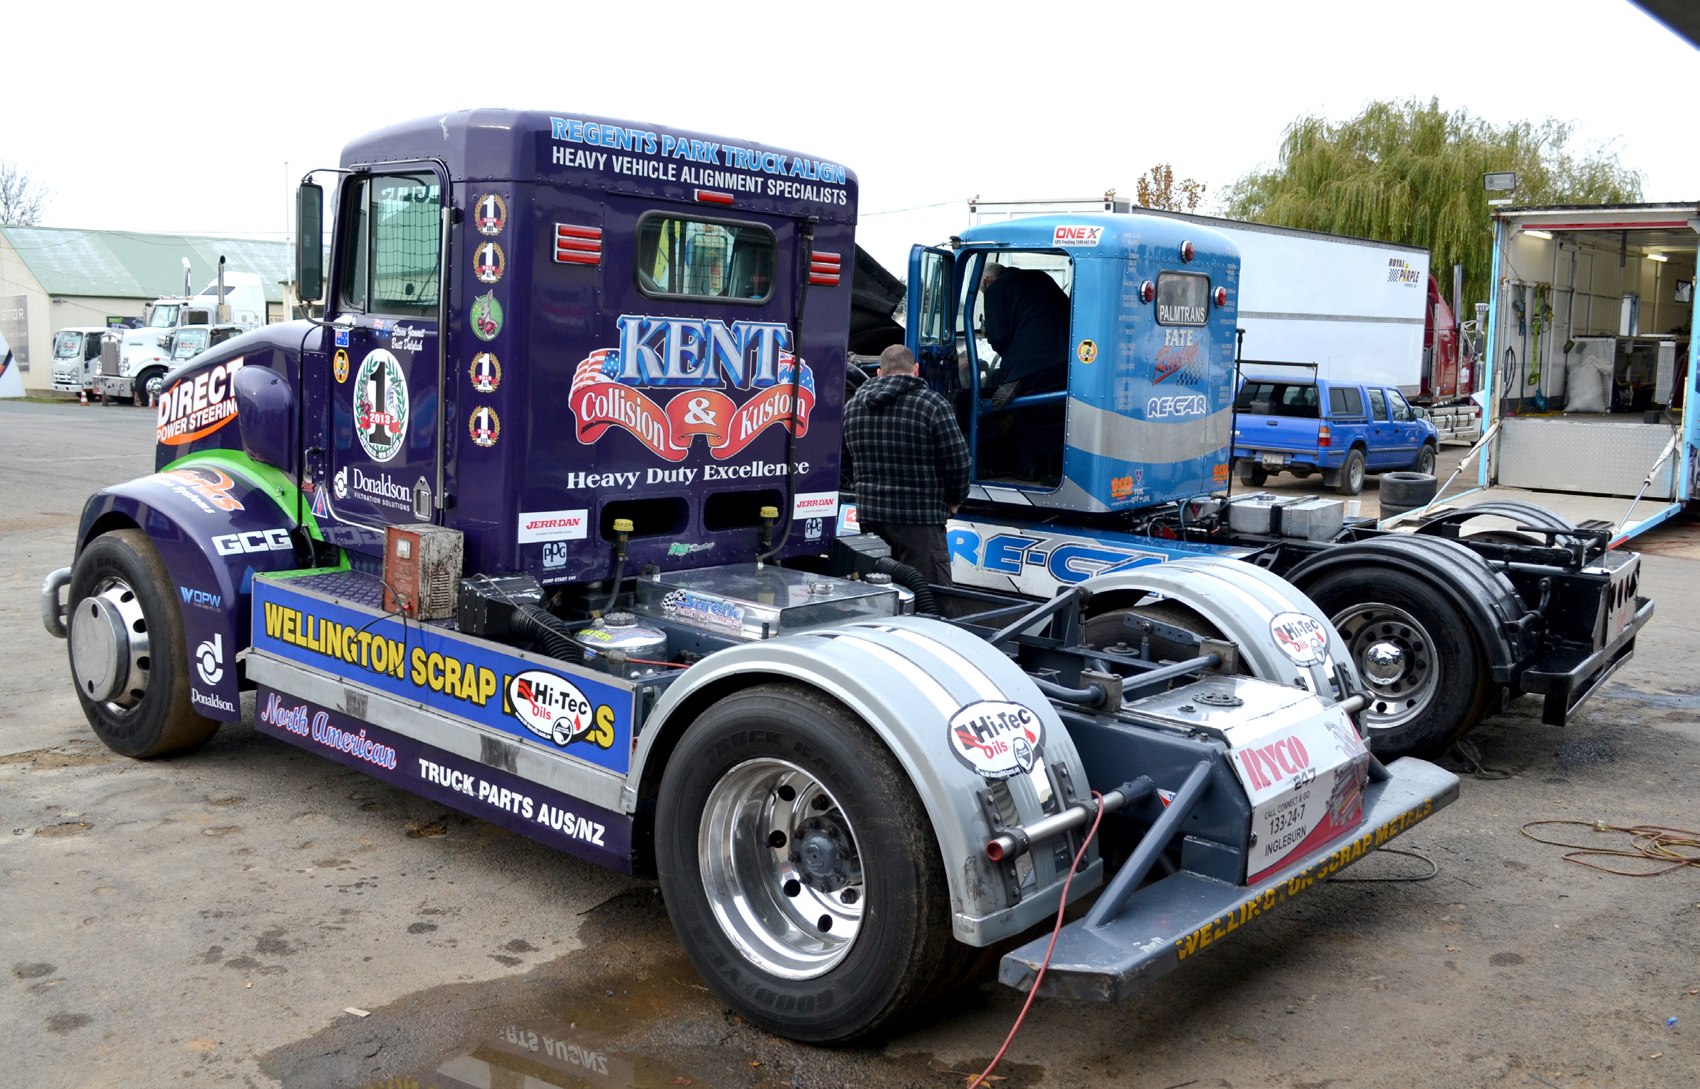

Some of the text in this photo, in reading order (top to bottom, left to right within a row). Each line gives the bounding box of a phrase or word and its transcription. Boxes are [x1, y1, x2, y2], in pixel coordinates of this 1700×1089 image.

[550, 116, 846, 185] REGENTS PARK TRUCK ALIGN
[552, 146, 847, 206] HEAVY VEHICLE ALIGNMENT SPECIALISTS
[1159, 304, 1206, 323] PALMTRANS
[616, 315, 793, 389] KENT
[1164, 329, 1194, 347] FATE
[157, 356, 245, 429] DIRECT
[156, 398, 239, 442] POWER STEERIN
[369, 413, 391, 424] 2013
[580, 390, 806, 452] Collision & Kustom
[353, 468, 411, 502] Donaldson
[566, 467, 641, 490] Heavy
[646, 465, 698, 486] Duty
[353, 492, 410, 512] FILTRATION SOLUTIONS
[210, 528, 294, 556] GCG
[263, 601, 405, 680] WELLINGTON
[1282, 619, 1319, 641] Hi-Tec
[410, 647, 497, 706] SCRAP
[191, 687, 235, 713] Donaldson
[532, 704, 552, 720] Oils
[534, 681, 588, 716] Hi-Tec
[261, 692, 398, 770] North American
[969, 708, 1032, 744] Hi-Tec
[983, 739, 1009, 760] Oils
[1238, 735, 1310, 792] RYCO
[418, 758, 606, 847] TRUCK PARTS AUS/NZ
[1264, 825, 1307, 857] INGLEBURN
[1316, 832, 1371, 880] SCRAP
